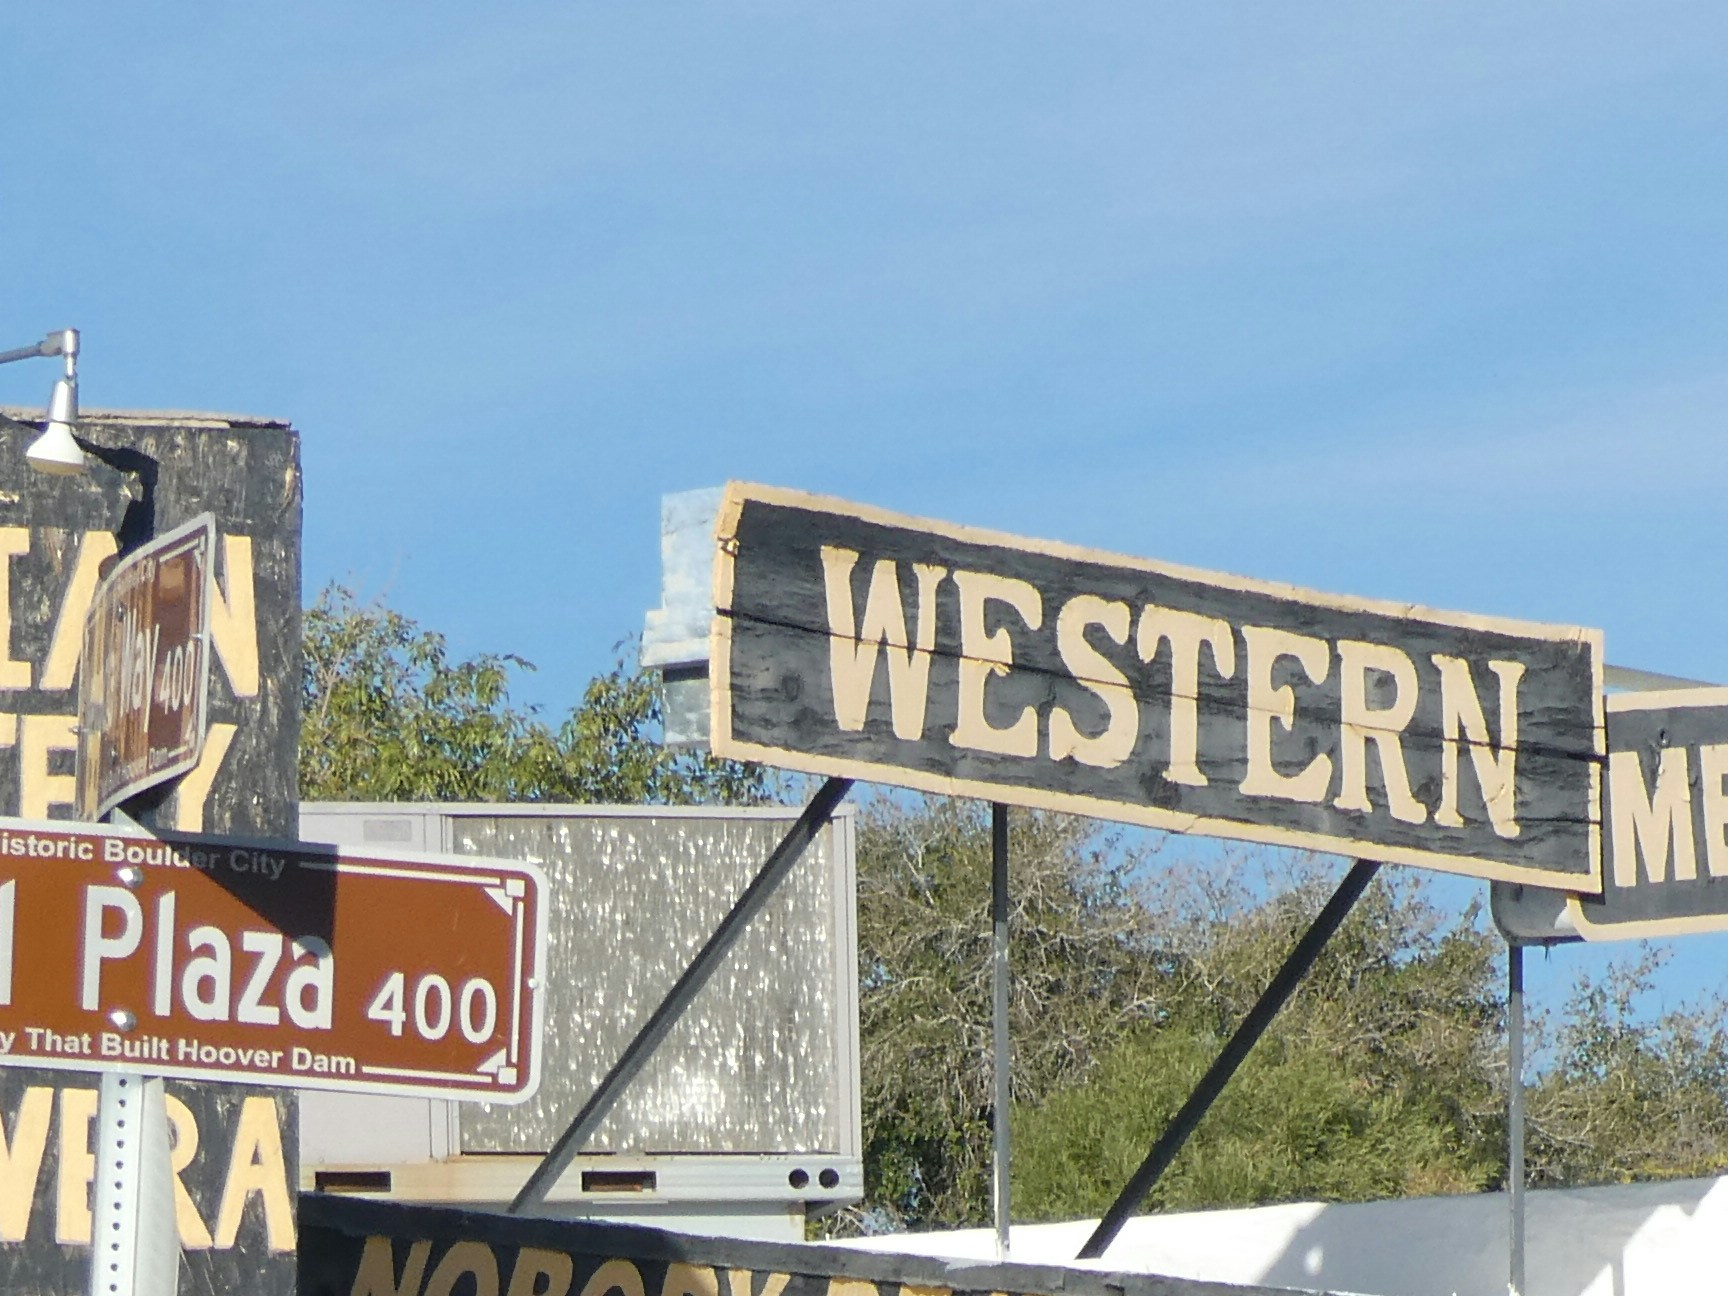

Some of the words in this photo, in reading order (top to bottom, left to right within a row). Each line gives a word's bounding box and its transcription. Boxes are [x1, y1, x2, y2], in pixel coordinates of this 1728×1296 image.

[159, 639, 195, 717] 400
[818, 543, 1526, 840] WESTERN
[103, 837, 220, 869] Boulder
[229, 849, 286, 881] City
[81, 883, 334, 1032] Plaza
[367, 971, 498, 1045] 400
[24, 1026, 92, 1056] That
[99, 1031, 171, 1062] Built
[176, 1037, 283, 1069] Hoover
[290, 1044, 357, 1076] Dam
